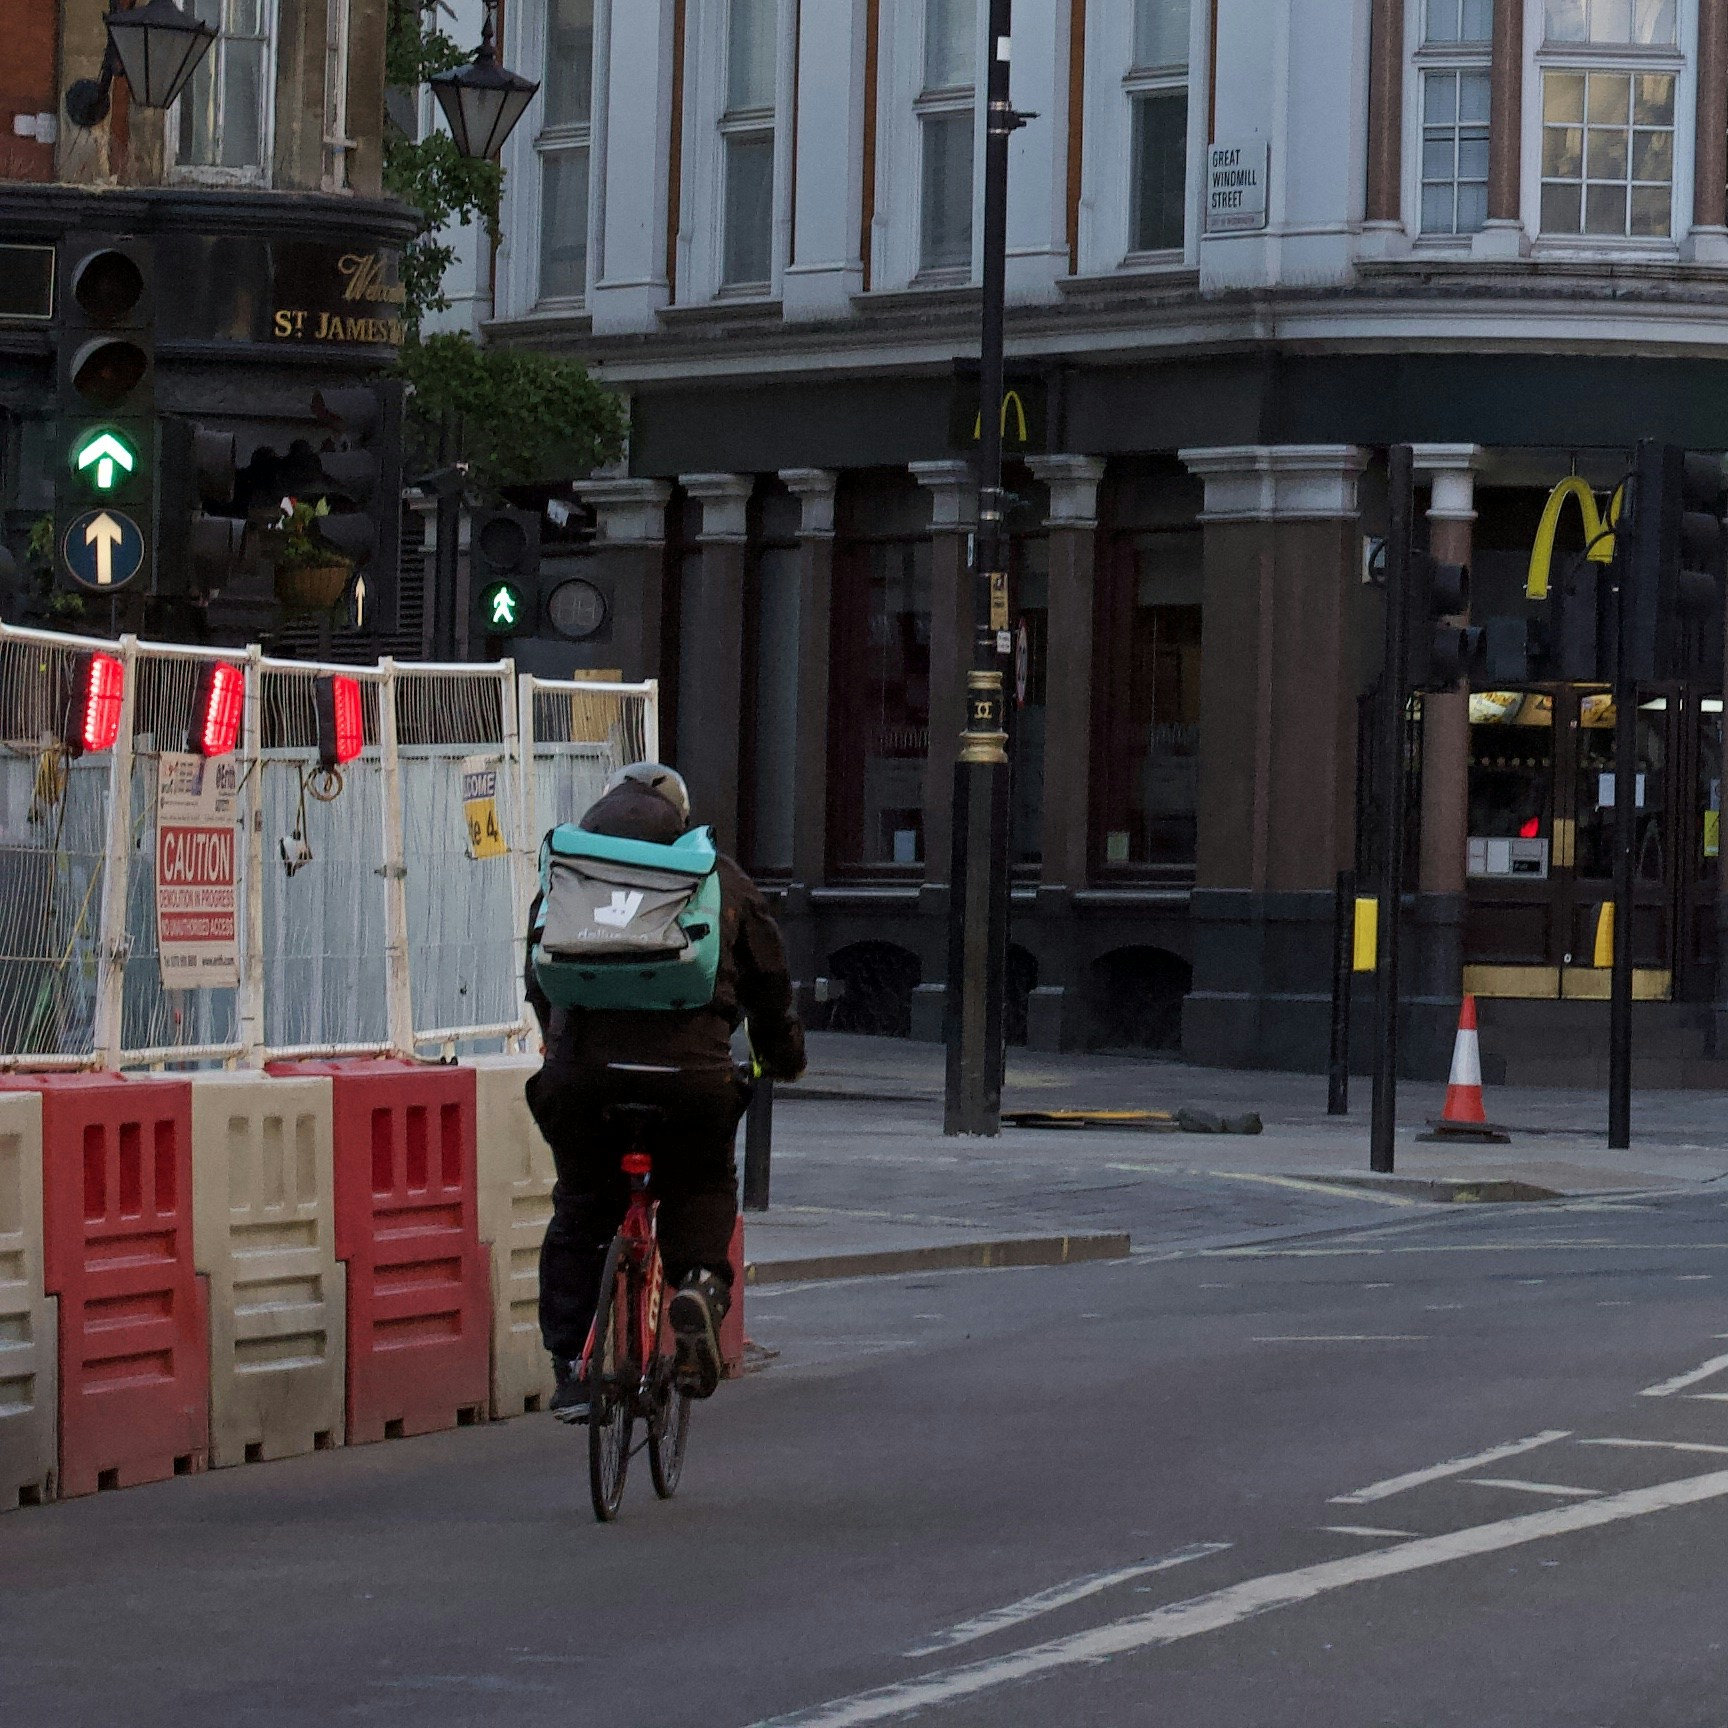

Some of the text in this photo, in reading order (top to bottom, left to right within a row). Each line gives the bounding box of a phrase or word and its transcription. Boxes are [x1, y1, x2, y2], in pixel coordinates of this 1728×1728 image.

[1212, 148, 1241, 168] GREAT
[1213, 169, 1257, 188] WINDMILL
[1211, 190, 1243, 209] STREET
[486, 810, 498, 843] 4
[164, 832, 231, 881] CAUTION
[160, 889, 234, 908] DEMOLITION IN PROGRESS
[210, 918, 233, 936] ACCESS
